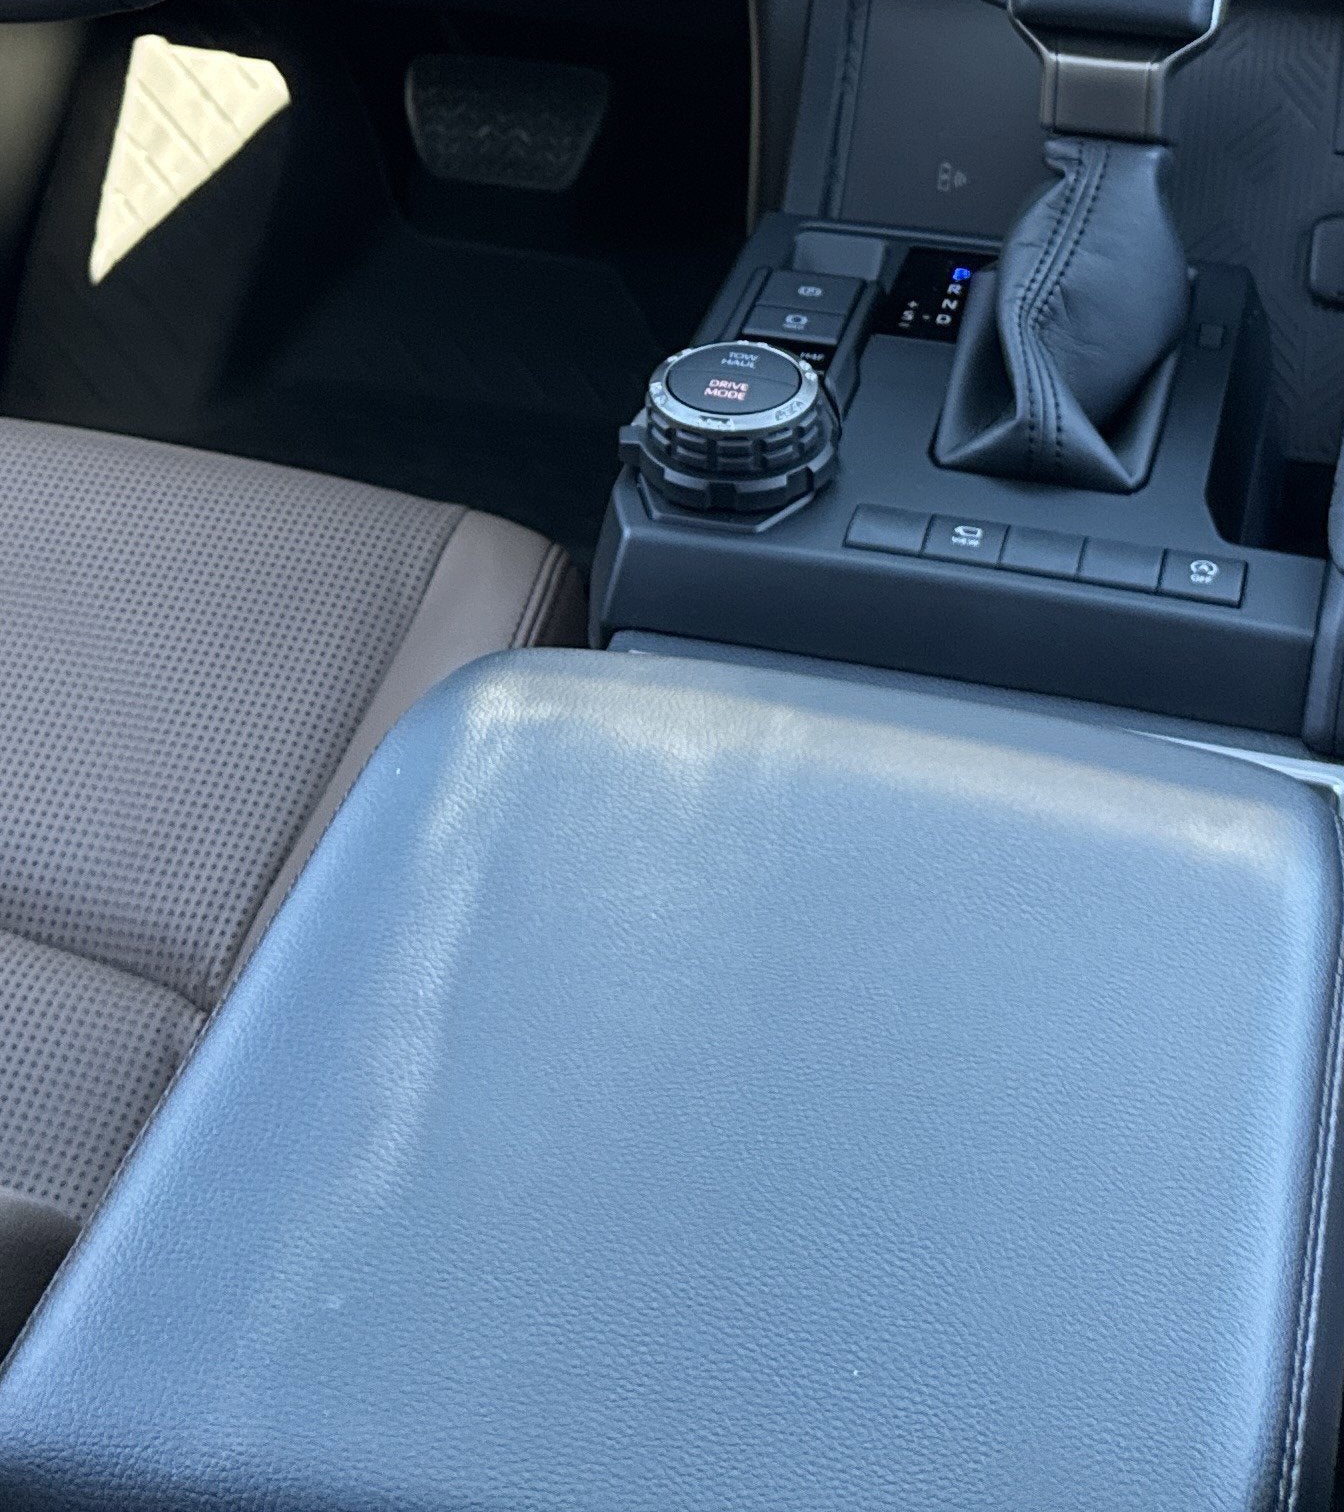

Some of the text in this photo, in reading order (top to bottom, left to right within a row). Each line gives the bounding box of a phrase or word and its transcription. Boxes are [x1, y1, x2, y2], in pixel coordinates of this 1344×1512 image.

[941, 298, 959, 311] N
[935, 313, 953, 327] D
[708, 378, 750, 392] DRIVE
[703, 387, 747, 402] MODE
